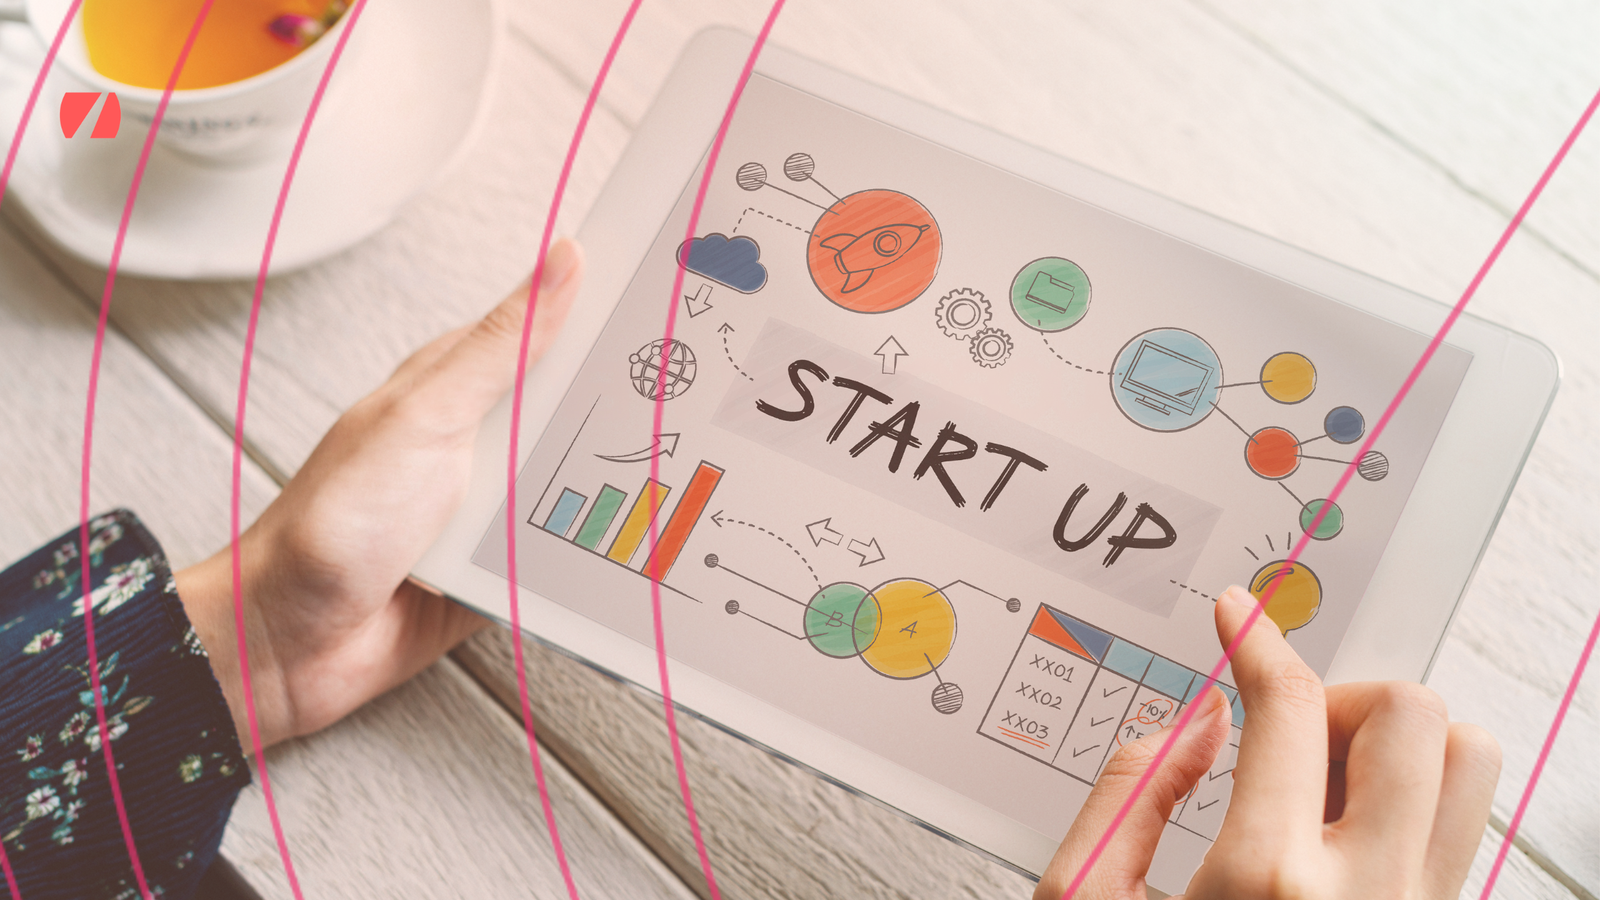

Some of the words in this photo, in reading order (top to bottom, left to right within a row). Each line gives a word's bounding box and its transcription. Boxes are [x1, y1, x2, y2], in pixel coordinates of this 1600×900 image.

[755, 359, 1048, 512] START
[1053, 483, 1177, 568] UP
[825, 610, 844, 628] B
[899, 620, 918, 639] A
